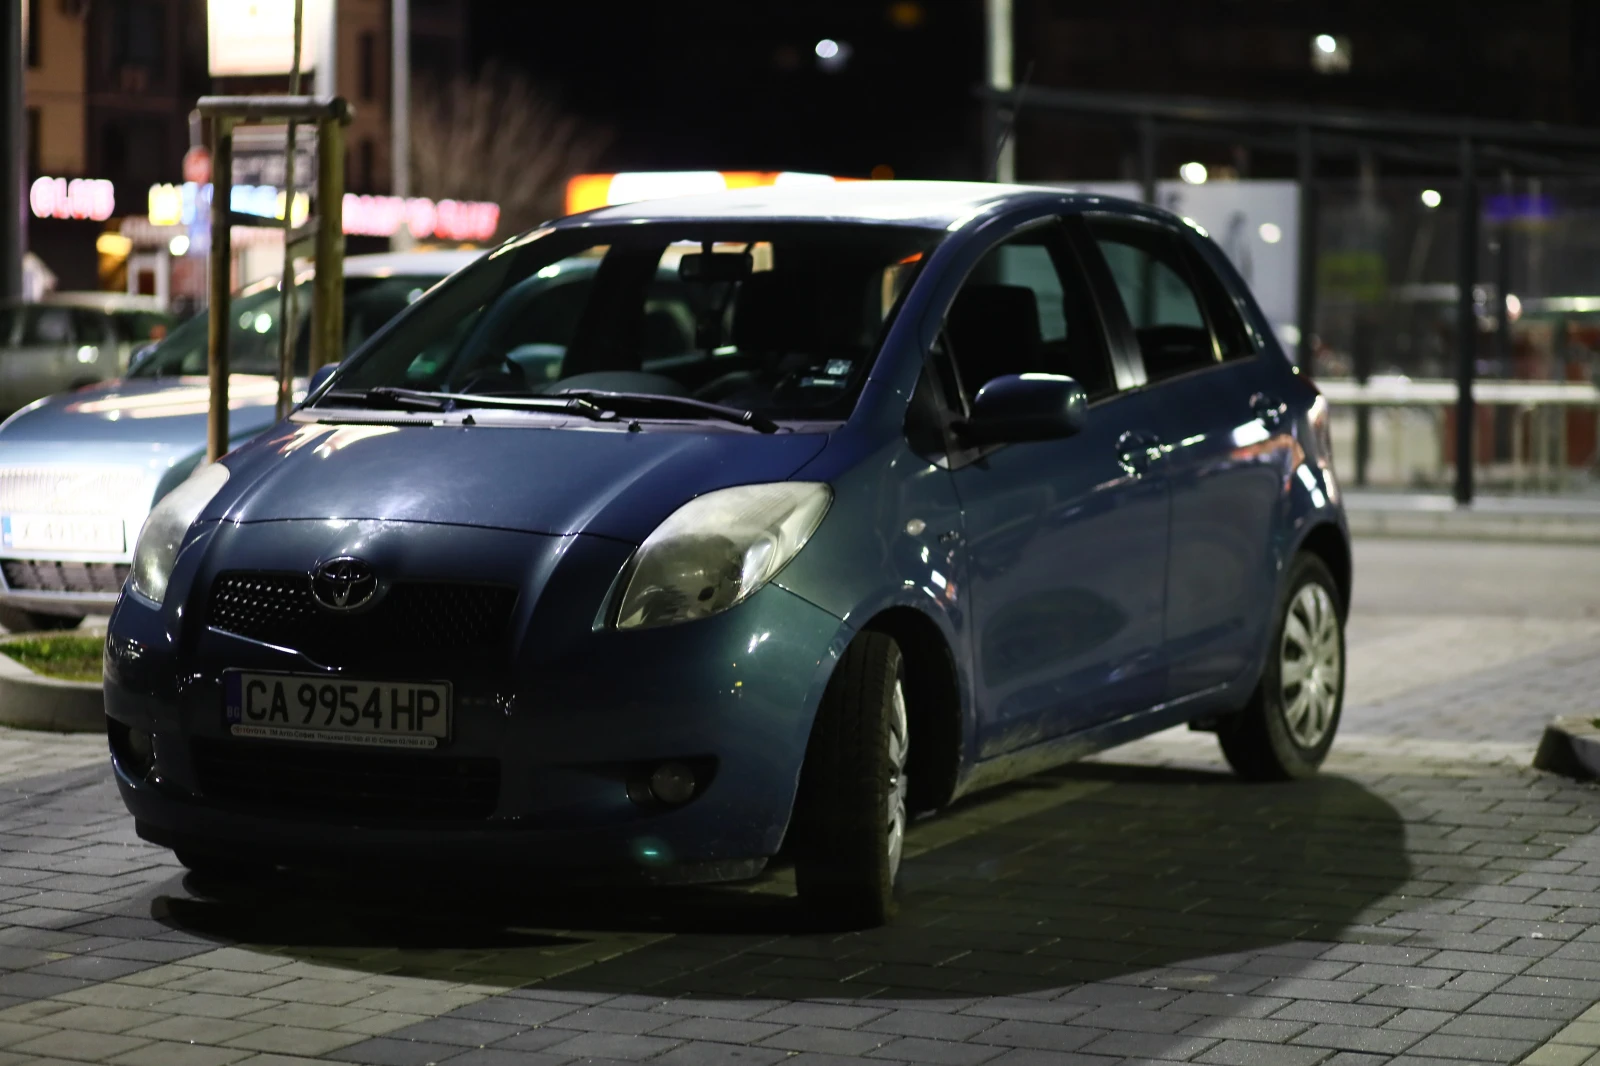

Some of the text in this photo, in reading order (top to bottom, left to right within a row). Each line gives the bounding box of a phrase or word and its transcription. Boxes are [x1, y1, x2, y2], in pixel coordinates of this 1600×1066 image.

[246, 679, 440, 731] CA 9954 HP
